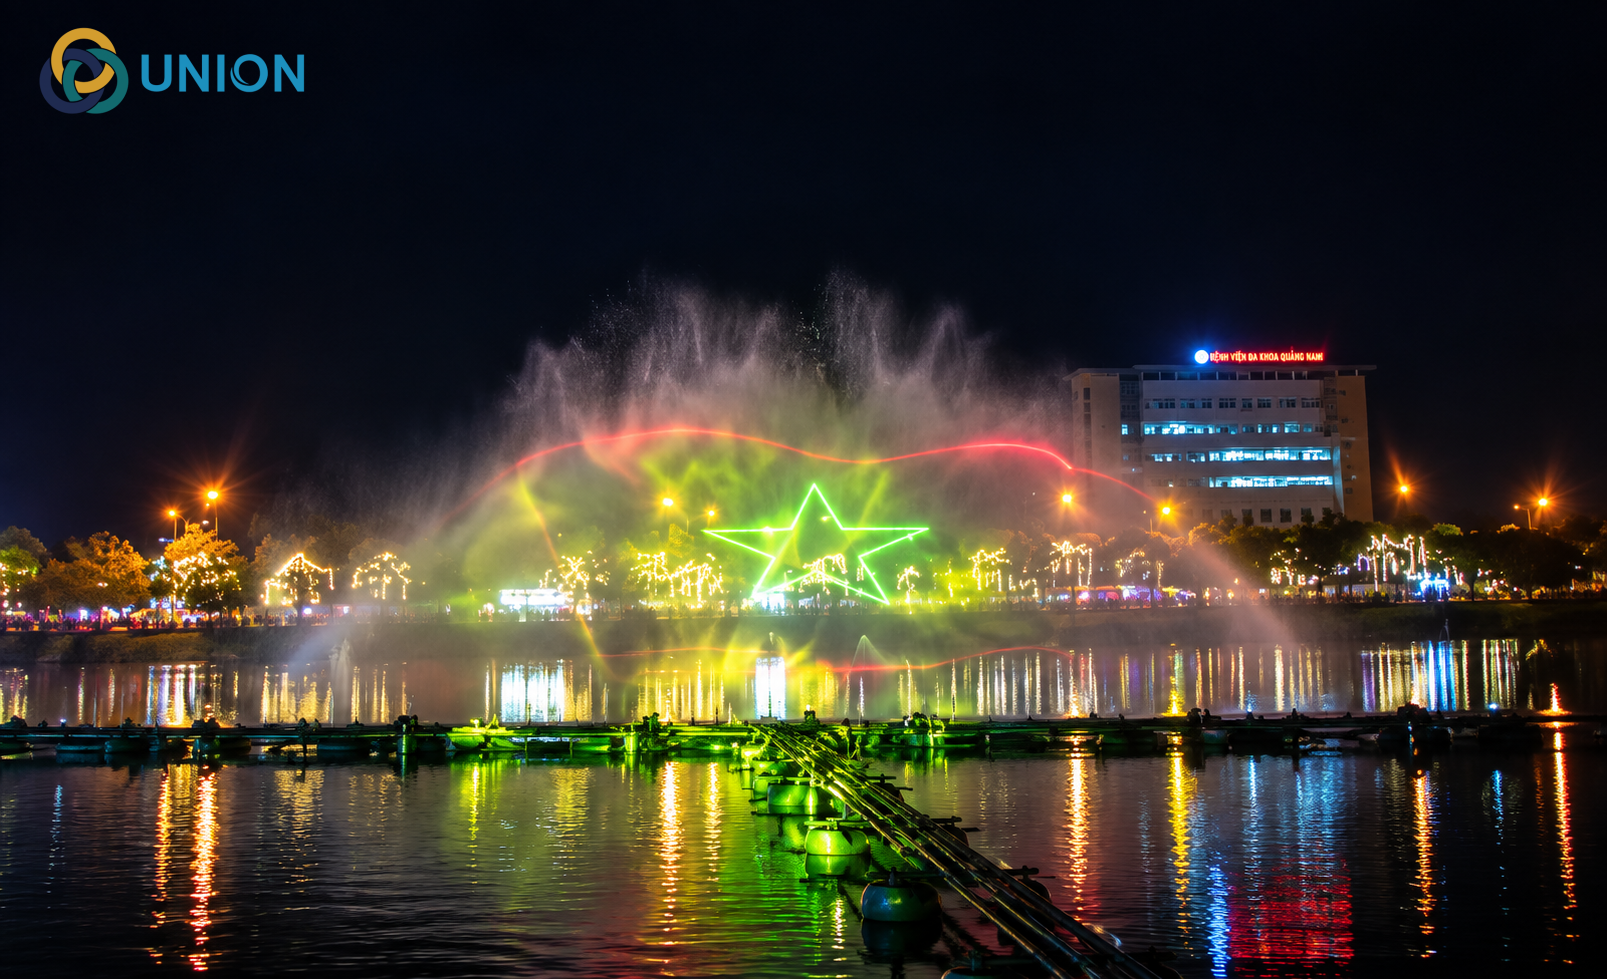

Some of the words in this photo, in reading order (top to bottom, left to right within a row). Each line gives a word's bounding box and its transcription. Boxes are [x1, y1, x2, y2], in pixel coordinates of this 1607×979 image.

[1259, 352, 1279, 362] KHOA
[1280, 349, 1304, 362] QUẢNG
[1306, 352, 1323, 362] NAM
